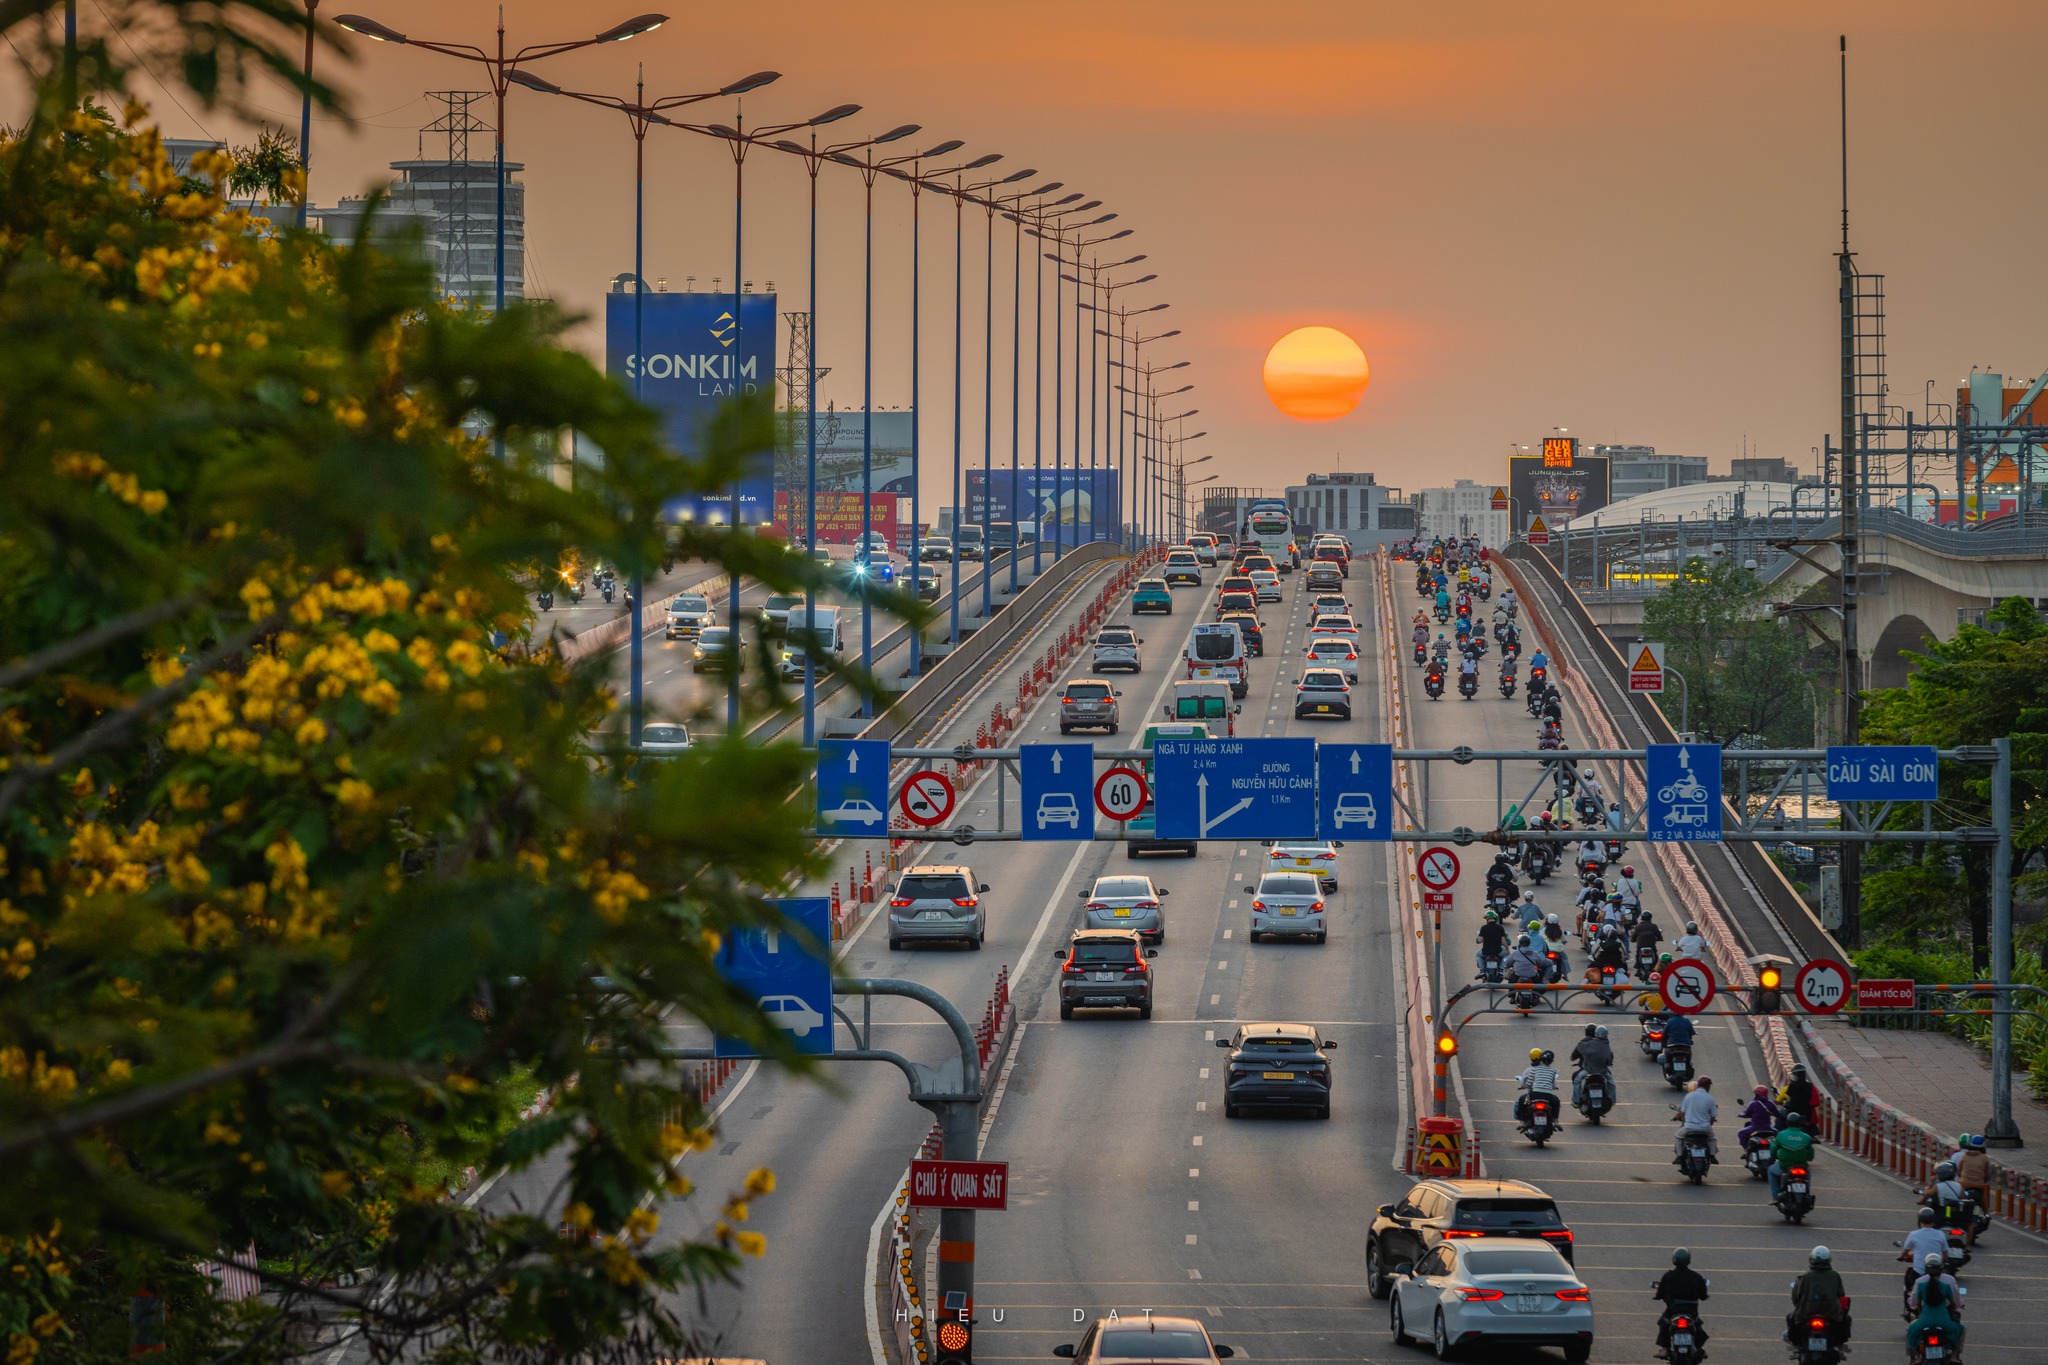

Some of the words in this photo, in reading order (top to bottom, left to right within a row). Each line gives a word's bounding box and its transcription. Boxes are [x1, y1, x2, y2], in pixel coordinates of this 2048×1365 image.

[626, 354, 757, 379] SONKIM
[1545, 440, 1571, 449] JUN
[1545, 449, 1571, 458] GER
[702, 494, 757, 502] sonkimld.vn
[1158, 741, 1176, 755] NGÃ
[1178, 743, 1190, 755] TƯ
[1193, 741, 1217, 755] HÀNG
[1220, 743, 1243, 754] XANH
[1193, 759, 1204, 769] 2,4
[1205, 759, 1217, 769] Km
[1262, 761, 1291, 773] ĐƯỜNG
[1829, 756, 1861, 783] CẦU
[1869, 758, 1895, 783] SÀI
[1903, 757, 1935, 783] GÒN
[1231, 774, 1266, 789] NGUYỄN
[1268, 775, 1287, 789] HỮU
[1289, 775, 1313, 789] CẢNH
[1110, 783, 1132, 806] 60
[1280, 794, 1291, 804] Km
[1651, 830, 1664, 840] XE
[1666, 830, 1673, 840] 2
[1673, 828, 1684, 840] VÀ
[1687, 830, 1693, 840] 3
[1695, 828, 1720, 840] BÁNH
[1860, 987, 1881, 998] GIẢM
[1882, 987, 1899, 998] TỐC
[1900, 989, 1912, 1000] ĐỘ
[915, 1166, 937, 1196] CHÚ
[940, 1167, 947, 1197] Ý
[951, 1173, 978, 1201] QUAN
[982, 1168, 1003, 1199] SÁT
